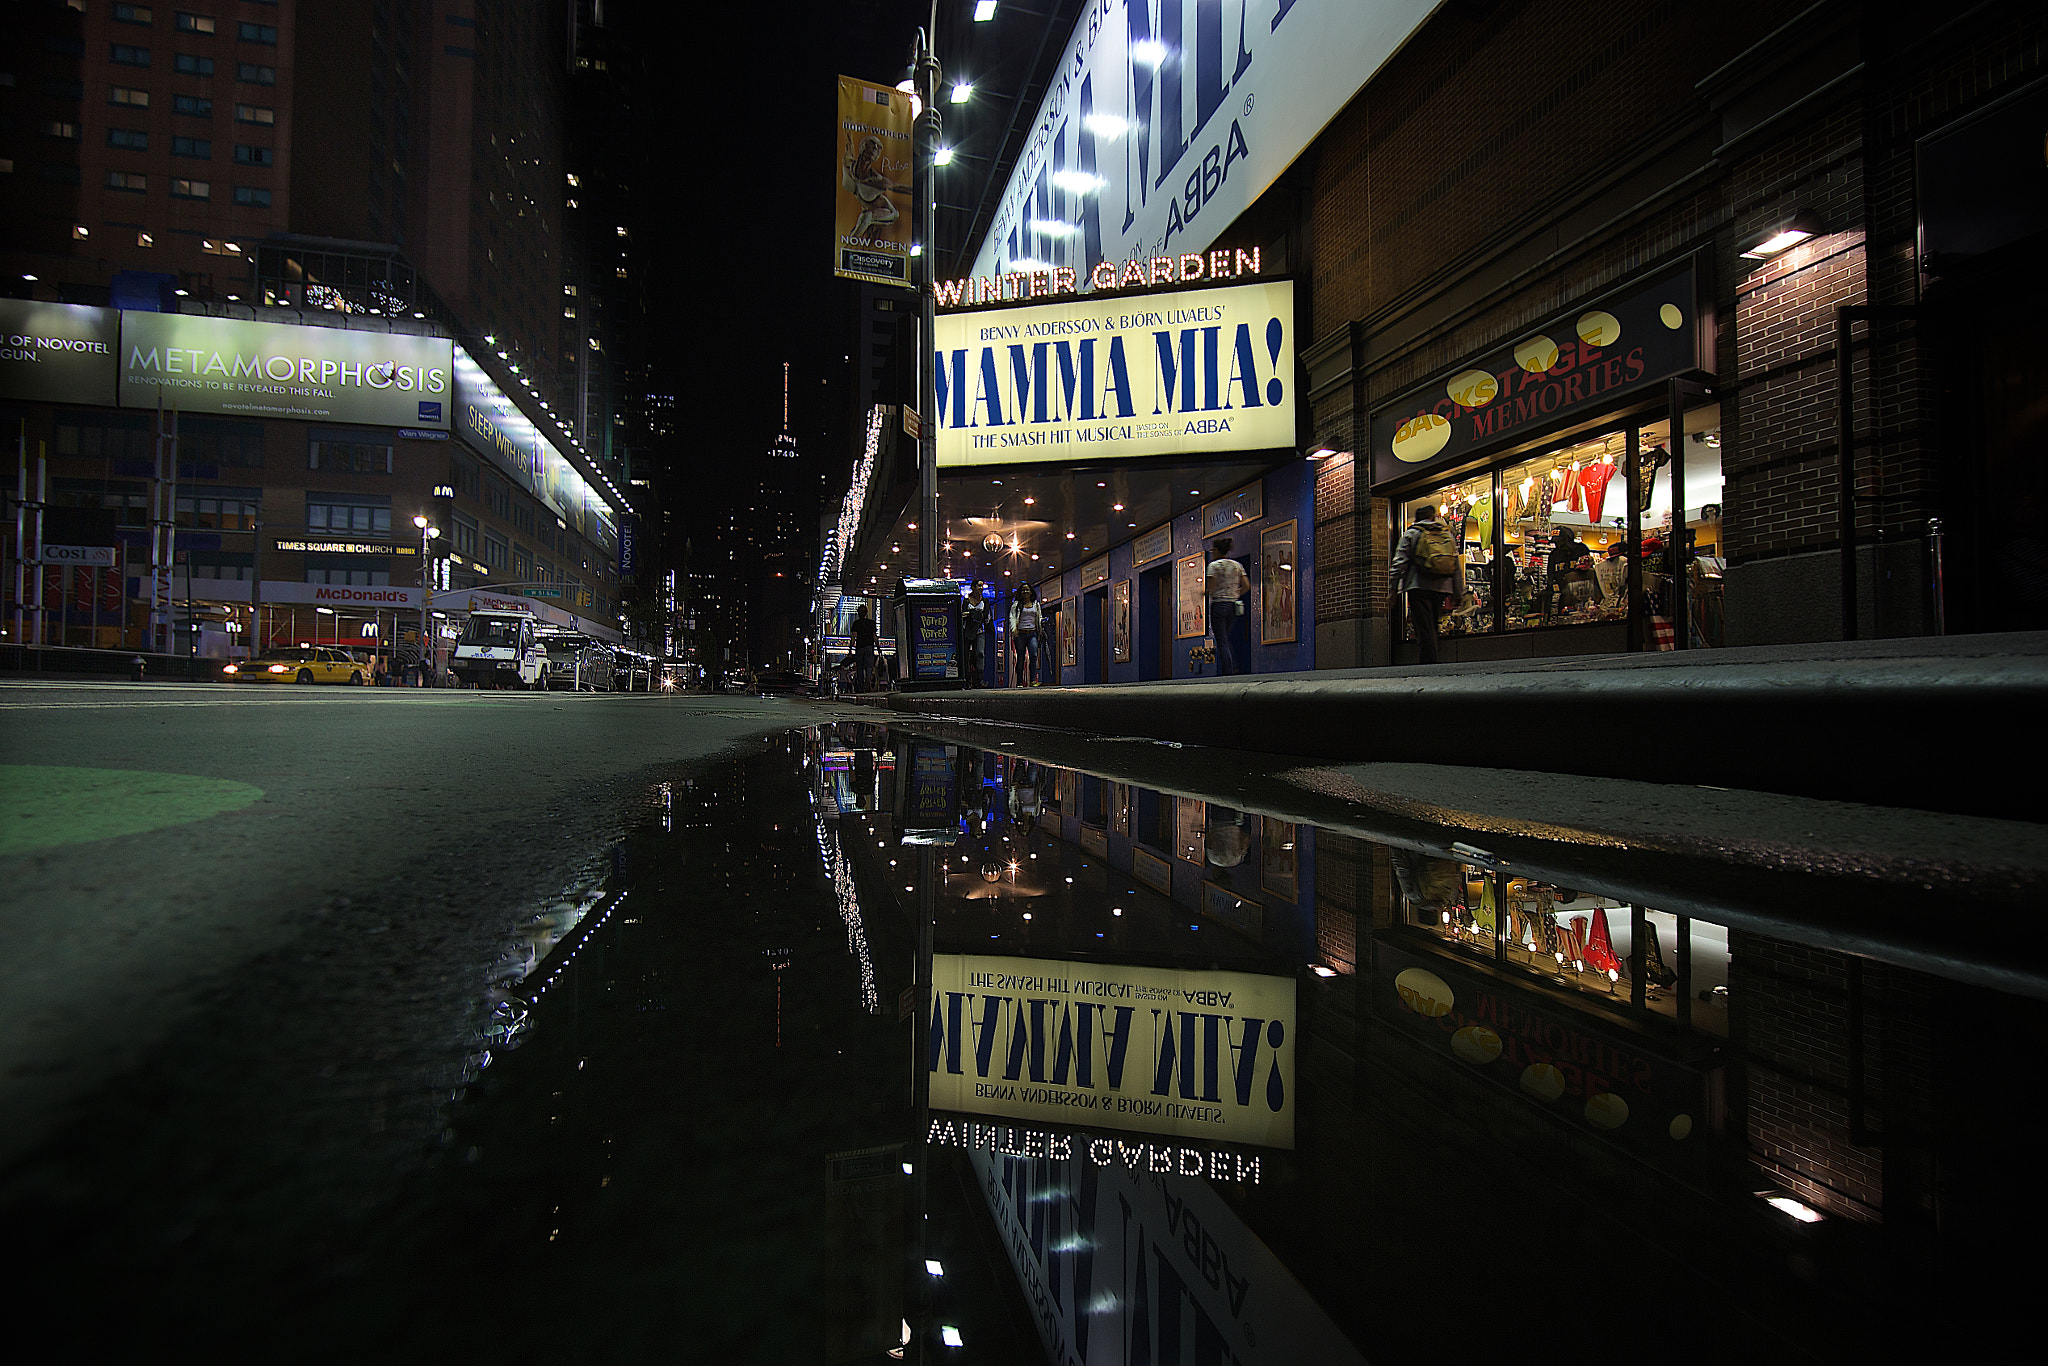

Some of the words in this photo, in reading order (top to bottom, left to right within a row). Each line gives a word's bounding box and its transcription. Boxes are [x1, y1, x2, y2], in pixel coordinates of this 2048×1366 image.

[1074, 40, 1084, 78] &
[843, 121, 870, 133] BODY
[871, 126, 909, 140] WORLDS
[840, 235, 871, 247] NOW
[874, 239, 907, 252] OPEN
[933, 267, 1076, 307] WINTER
[1092, 246, 1260, 290] GARDEN
[980, 325, 1021, 341] BENNY
[1024, 317, 1100, 338] ANDERSSON
[1105, 316, 1115, 331] &
[1120, 310, 1163, 331] BJÖRN
[1167, 304, 1226, 325] ULVAEUS'
[10, 334, 31, 348] OF
[36, 337, 110, 354] NOVOTEL
[128, 344, 446, 394] METAMORPHOSIS
[935, 336, 1136, 429] MAMMA
[1152, 317, 1284, 416] MIA!
[128, 375, 202, 389] RENOVATIONS
[205, 380, 220, 390] TO
[222, 382, 234, 391] BE
[237, 383, 287, 395] REVEALED
[289, 387, 310, 397] THIS
[312, 388, 336, 399] FALL.
[1394, 326, 1603, 445] BACKSTAGE
[1472, 347, 1645, 442] MEMORIES
[222, 403, 330, 416] novotelmetamorphosis.com
[402, 430, 417, 438] Van
[418, 431, 446, 441] Wagner
[468, 404, 494, 442] SLEEP
[494, 427, 516, 463] WITH
[517, 450, 529, 476] US.
[972, 434, 998, 450] THE
[1000, 431, 1046, 449] SMASH
[1050, 429, 1072, 444] HIT
[1076, 425, 1135, 443] MUSICAL
[277, 541, 306, 551] TIMES
[307, 542, 345, 552] SQUARE
[355, 544, 393, 555] CHURCH
[622, 523, 632, 569] NOVOTEL
[315, 588, 409, 603] McDonald's
[920, 615, 948, 628] POTTED
[920, 627, 948, 642] POTTER
